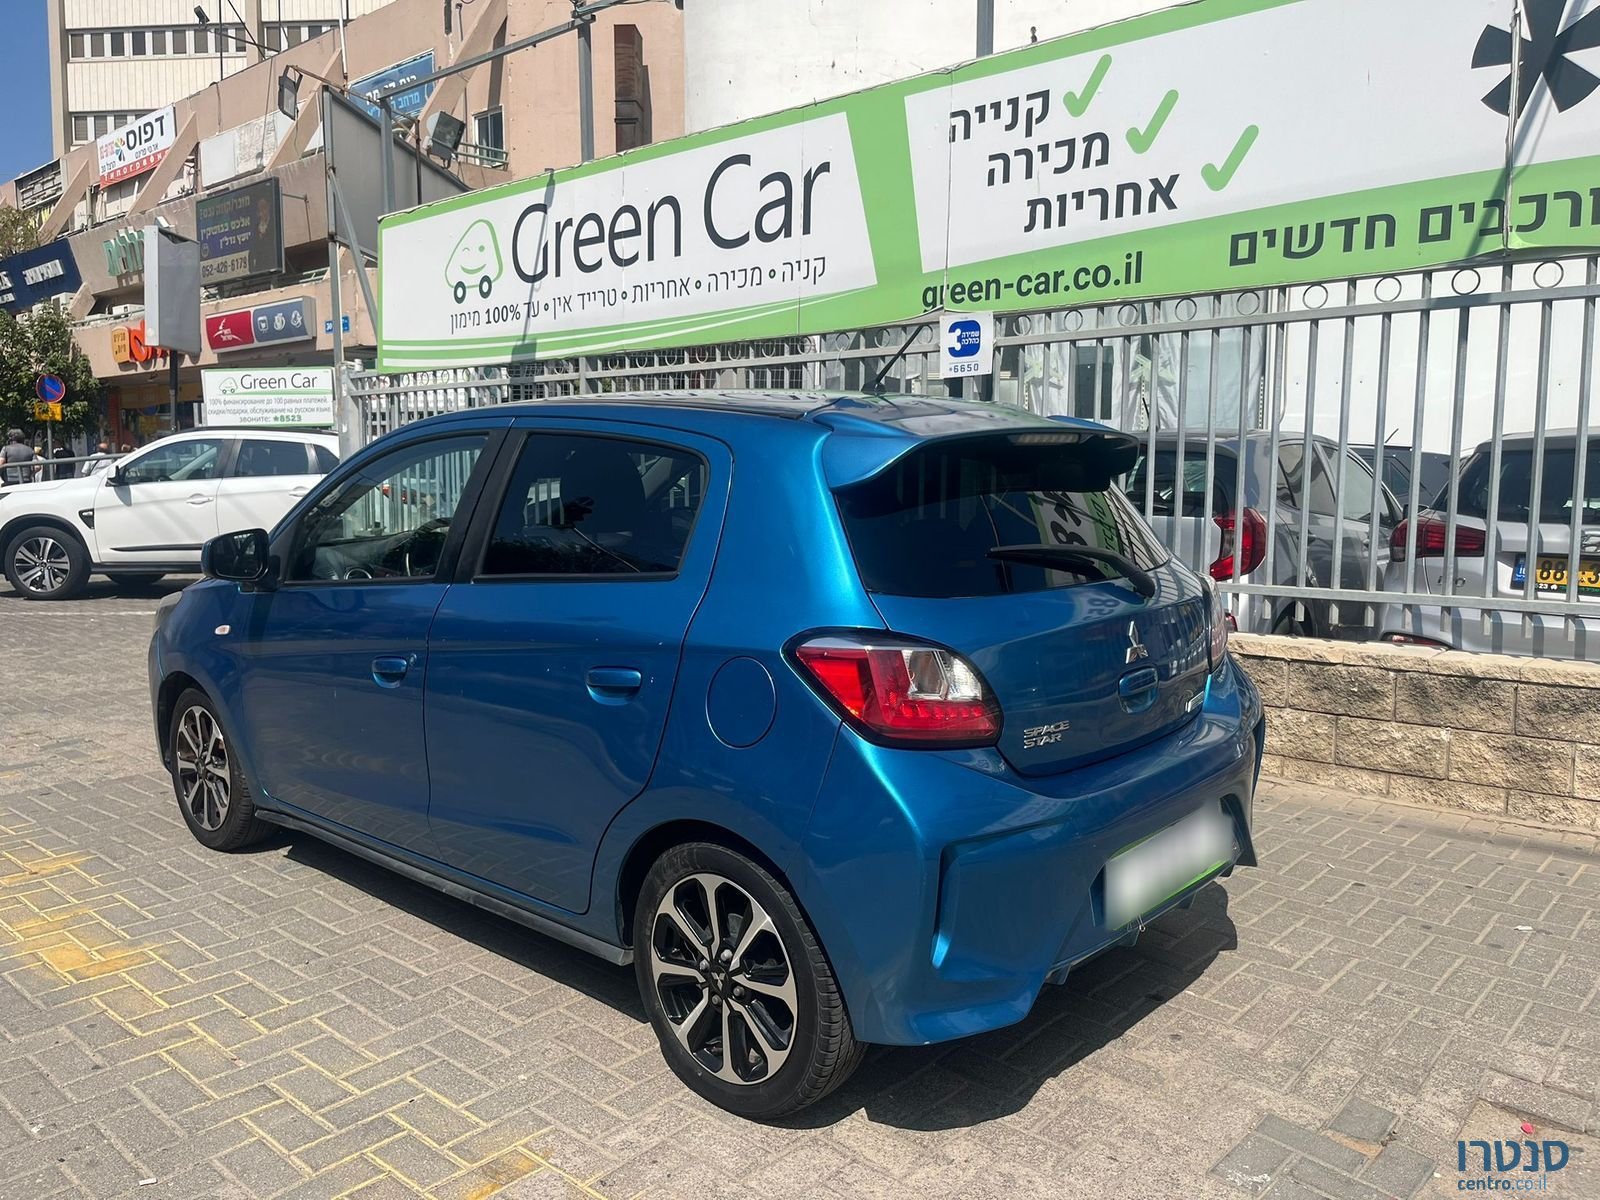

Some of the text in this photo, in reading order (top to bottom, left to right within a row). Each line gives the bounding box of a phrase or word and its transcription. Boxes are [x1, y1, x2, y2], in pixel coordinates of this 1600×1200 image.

[126, 115, 164, 151] דפוס
[949, 89, 1050, 143] קנייה
[987, 132, 1109, 187] מכירה
[512, 154, 831, 284] Green Car
[1023, 174, 1180, 233] אחריות
[1229, 213, 1396, 266] חדשים
[450, 256, 826, 335] קניה מכירה אחריות טרייד אין עד 100% מימון
[922, 251, 1143, 311] green-car.co.il
[961, 330, 980, 338] שמירה
[240, 373, 318, 389] Green Car
[1024, 720, 1070, 738] SPACE
[1024, 732, 1062, 749] STAR
